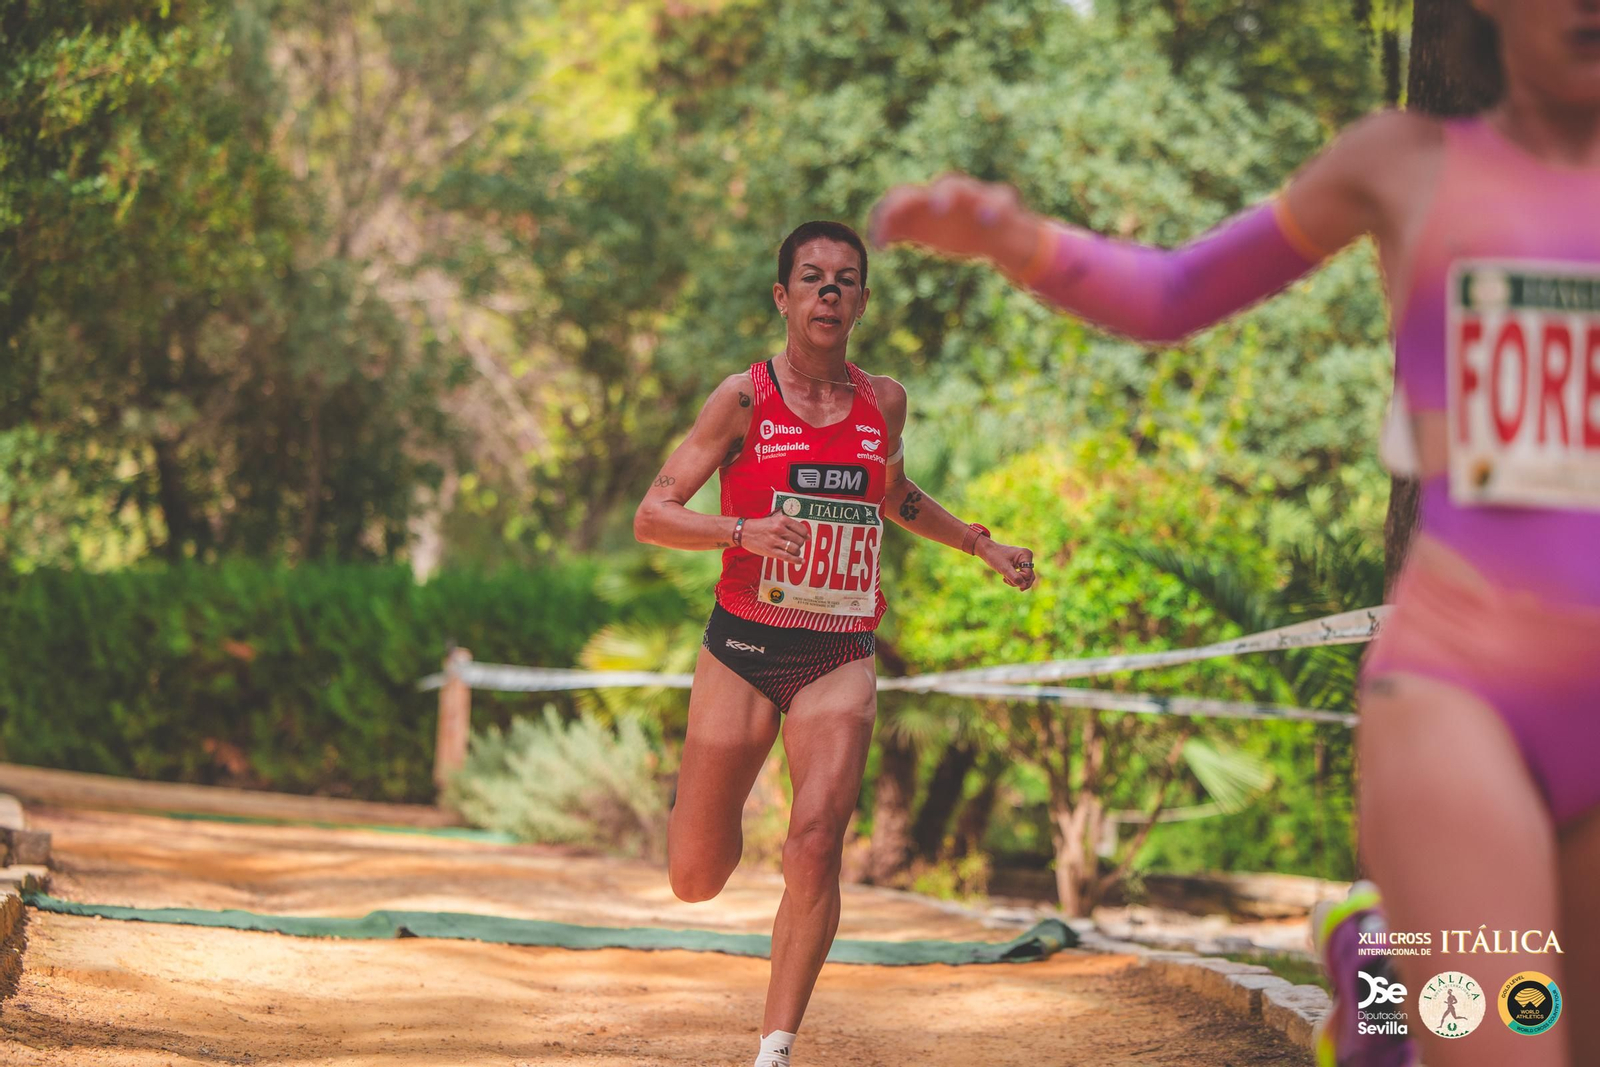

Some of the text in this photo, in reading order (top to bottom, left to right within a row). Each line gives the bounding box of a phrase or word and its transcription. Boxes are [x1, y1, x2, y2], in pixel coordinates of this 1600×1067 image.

[760, 420, 803, 440] Bilbao
[762, 442, 810, 454] Bizkaialde
[824, 469, 863, 491] BM
[808, 502, 860, 520] ITÁLICA
